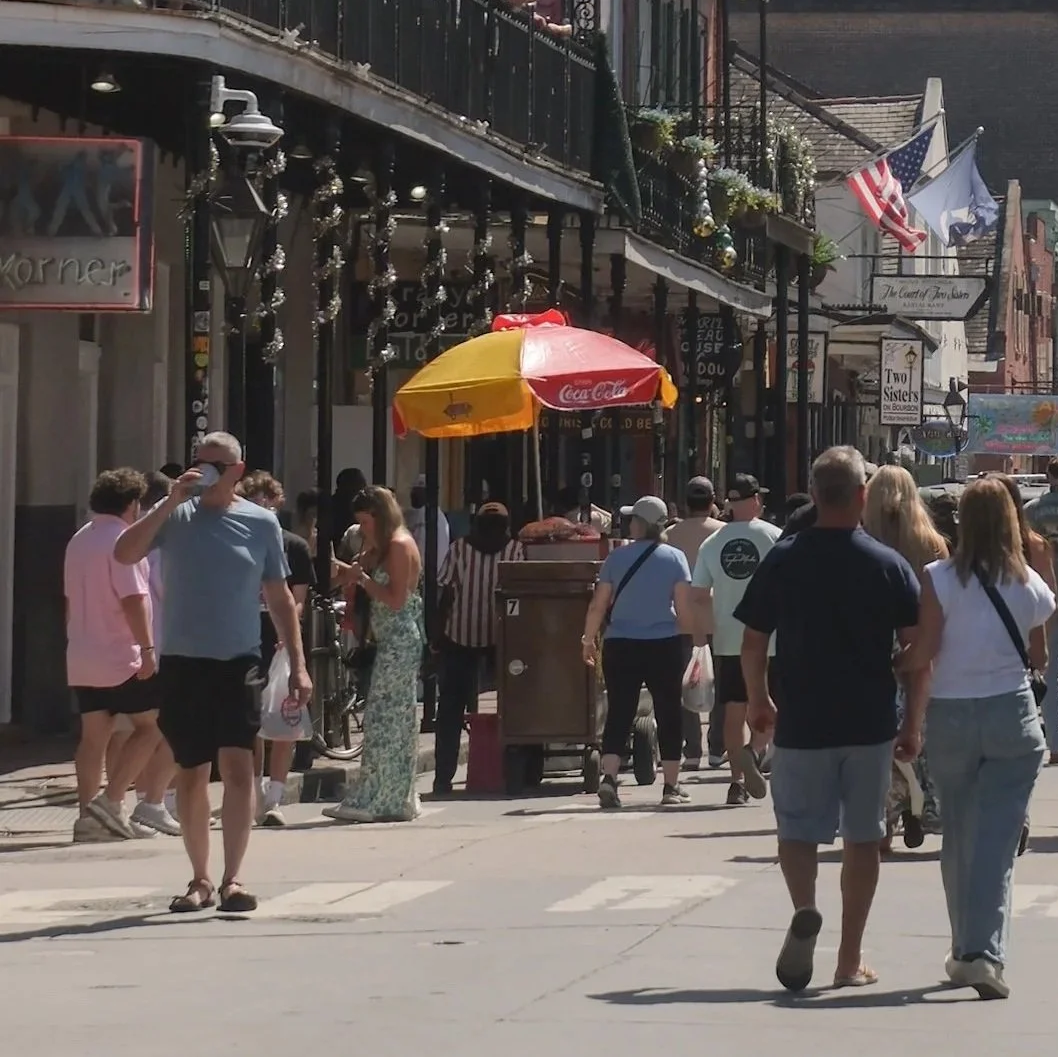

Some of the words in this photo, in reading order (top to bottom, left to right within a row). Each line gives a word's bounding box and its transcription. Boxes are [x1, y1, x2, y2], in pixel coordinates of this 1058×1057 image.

[882, 284, 897, 299] The
[898, 285, 918, 299] Court
[919, 289, 928, 301] of
[931, 285, 946, 300] Two
[884, 368, 907, 384] Two
[558, 379, 629, 403] Coca-Cola
[883, 385, 919, 402] Sisters
[509, 600, 518, 614] 7
